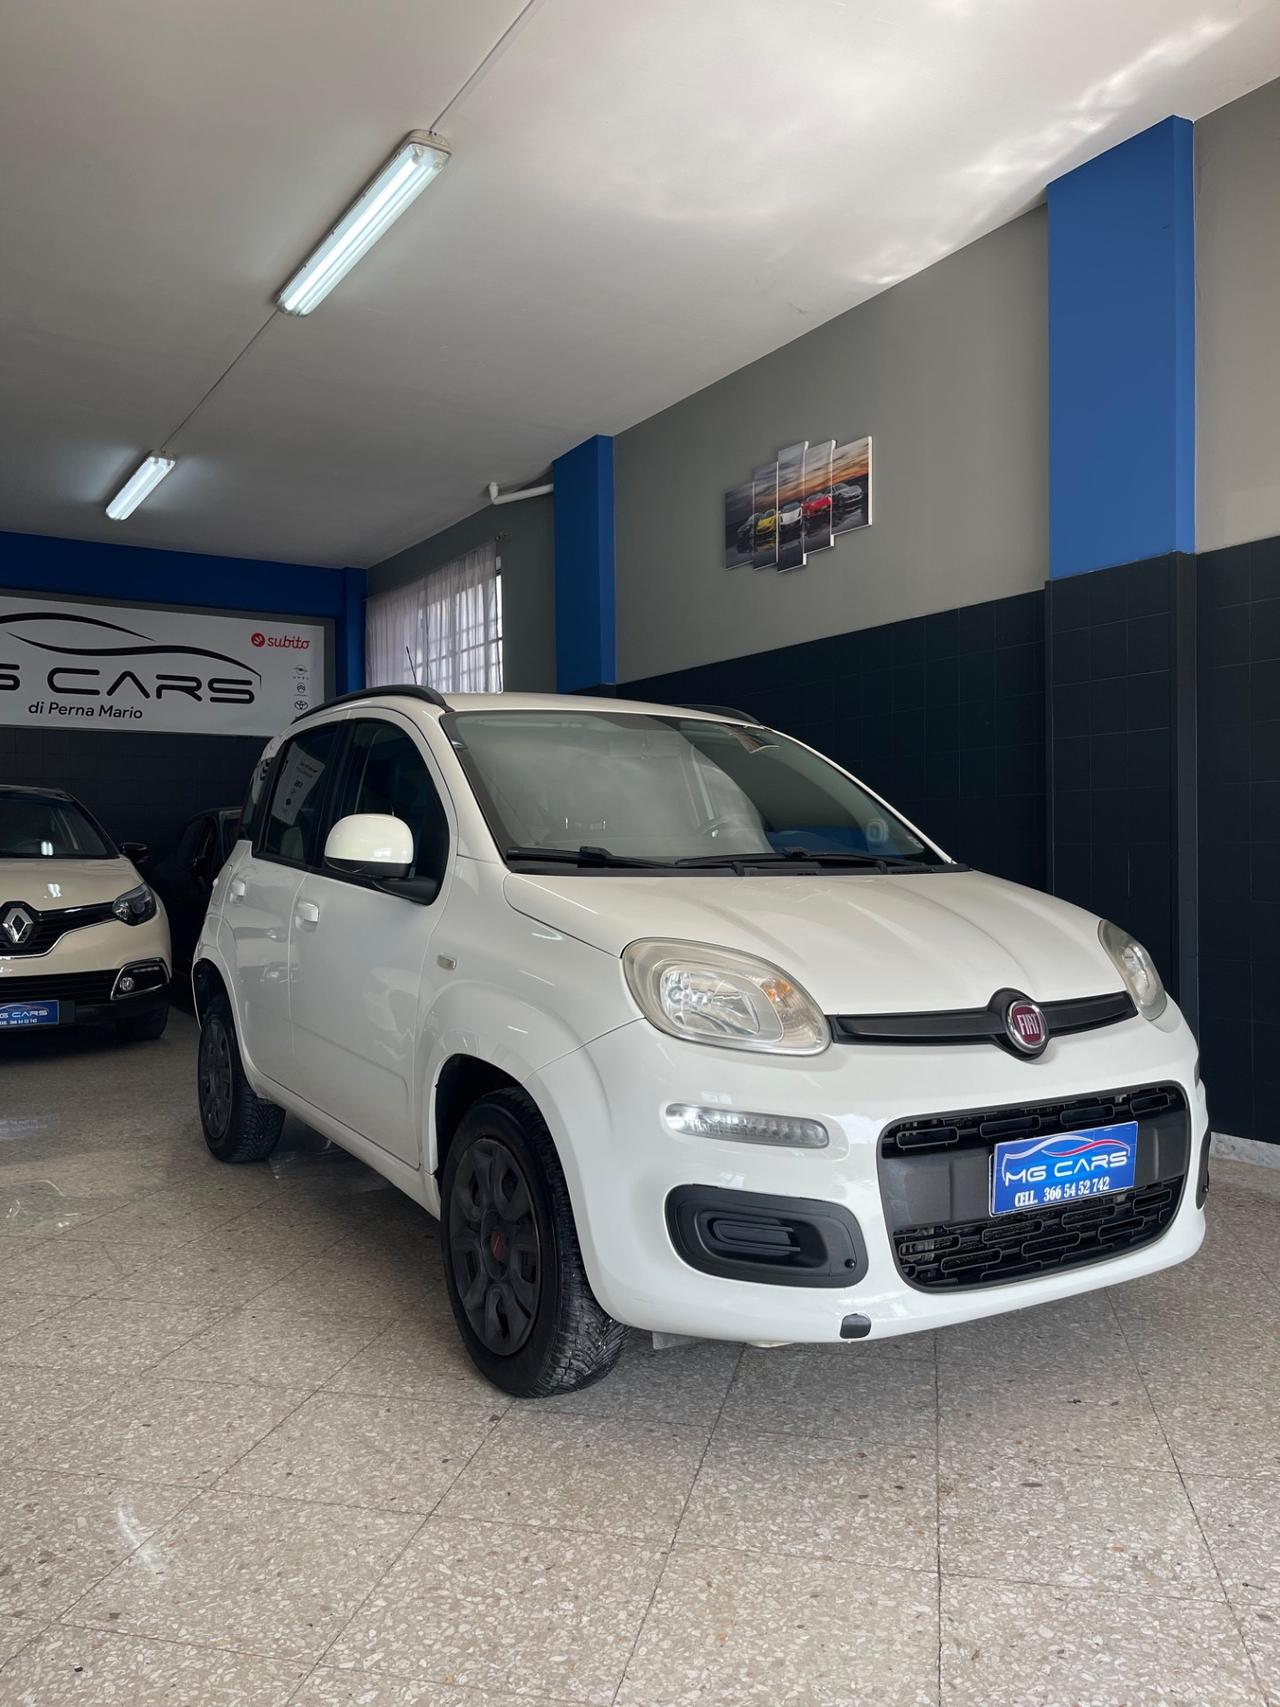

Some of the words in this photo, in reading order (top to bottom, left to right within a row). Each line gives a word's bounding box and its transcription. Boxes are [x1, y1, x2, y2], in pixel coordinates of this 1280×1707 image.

[267, 635, 310, 649] subito
[47, 667, 255, 704] CARS
[28, 701, 43, 714] di
[49, 702, 95, 717] Perna
[99, 704, 143, 719] Mario
[1016, 1013, 1040, 1035] FIAT
[1005, 1165, 1047, 1186] MG
[1054, 1151, 1128, 1177] CARS
[1014, 1190, 1038, 1207] CELL.
[1043, 1185, 1062, 1202] 366
[1064, 1182, 1076, 1198] 54
[1078, 1180, 1090, 1195] 52
[1092, 1176, 1110, 1192] 742
